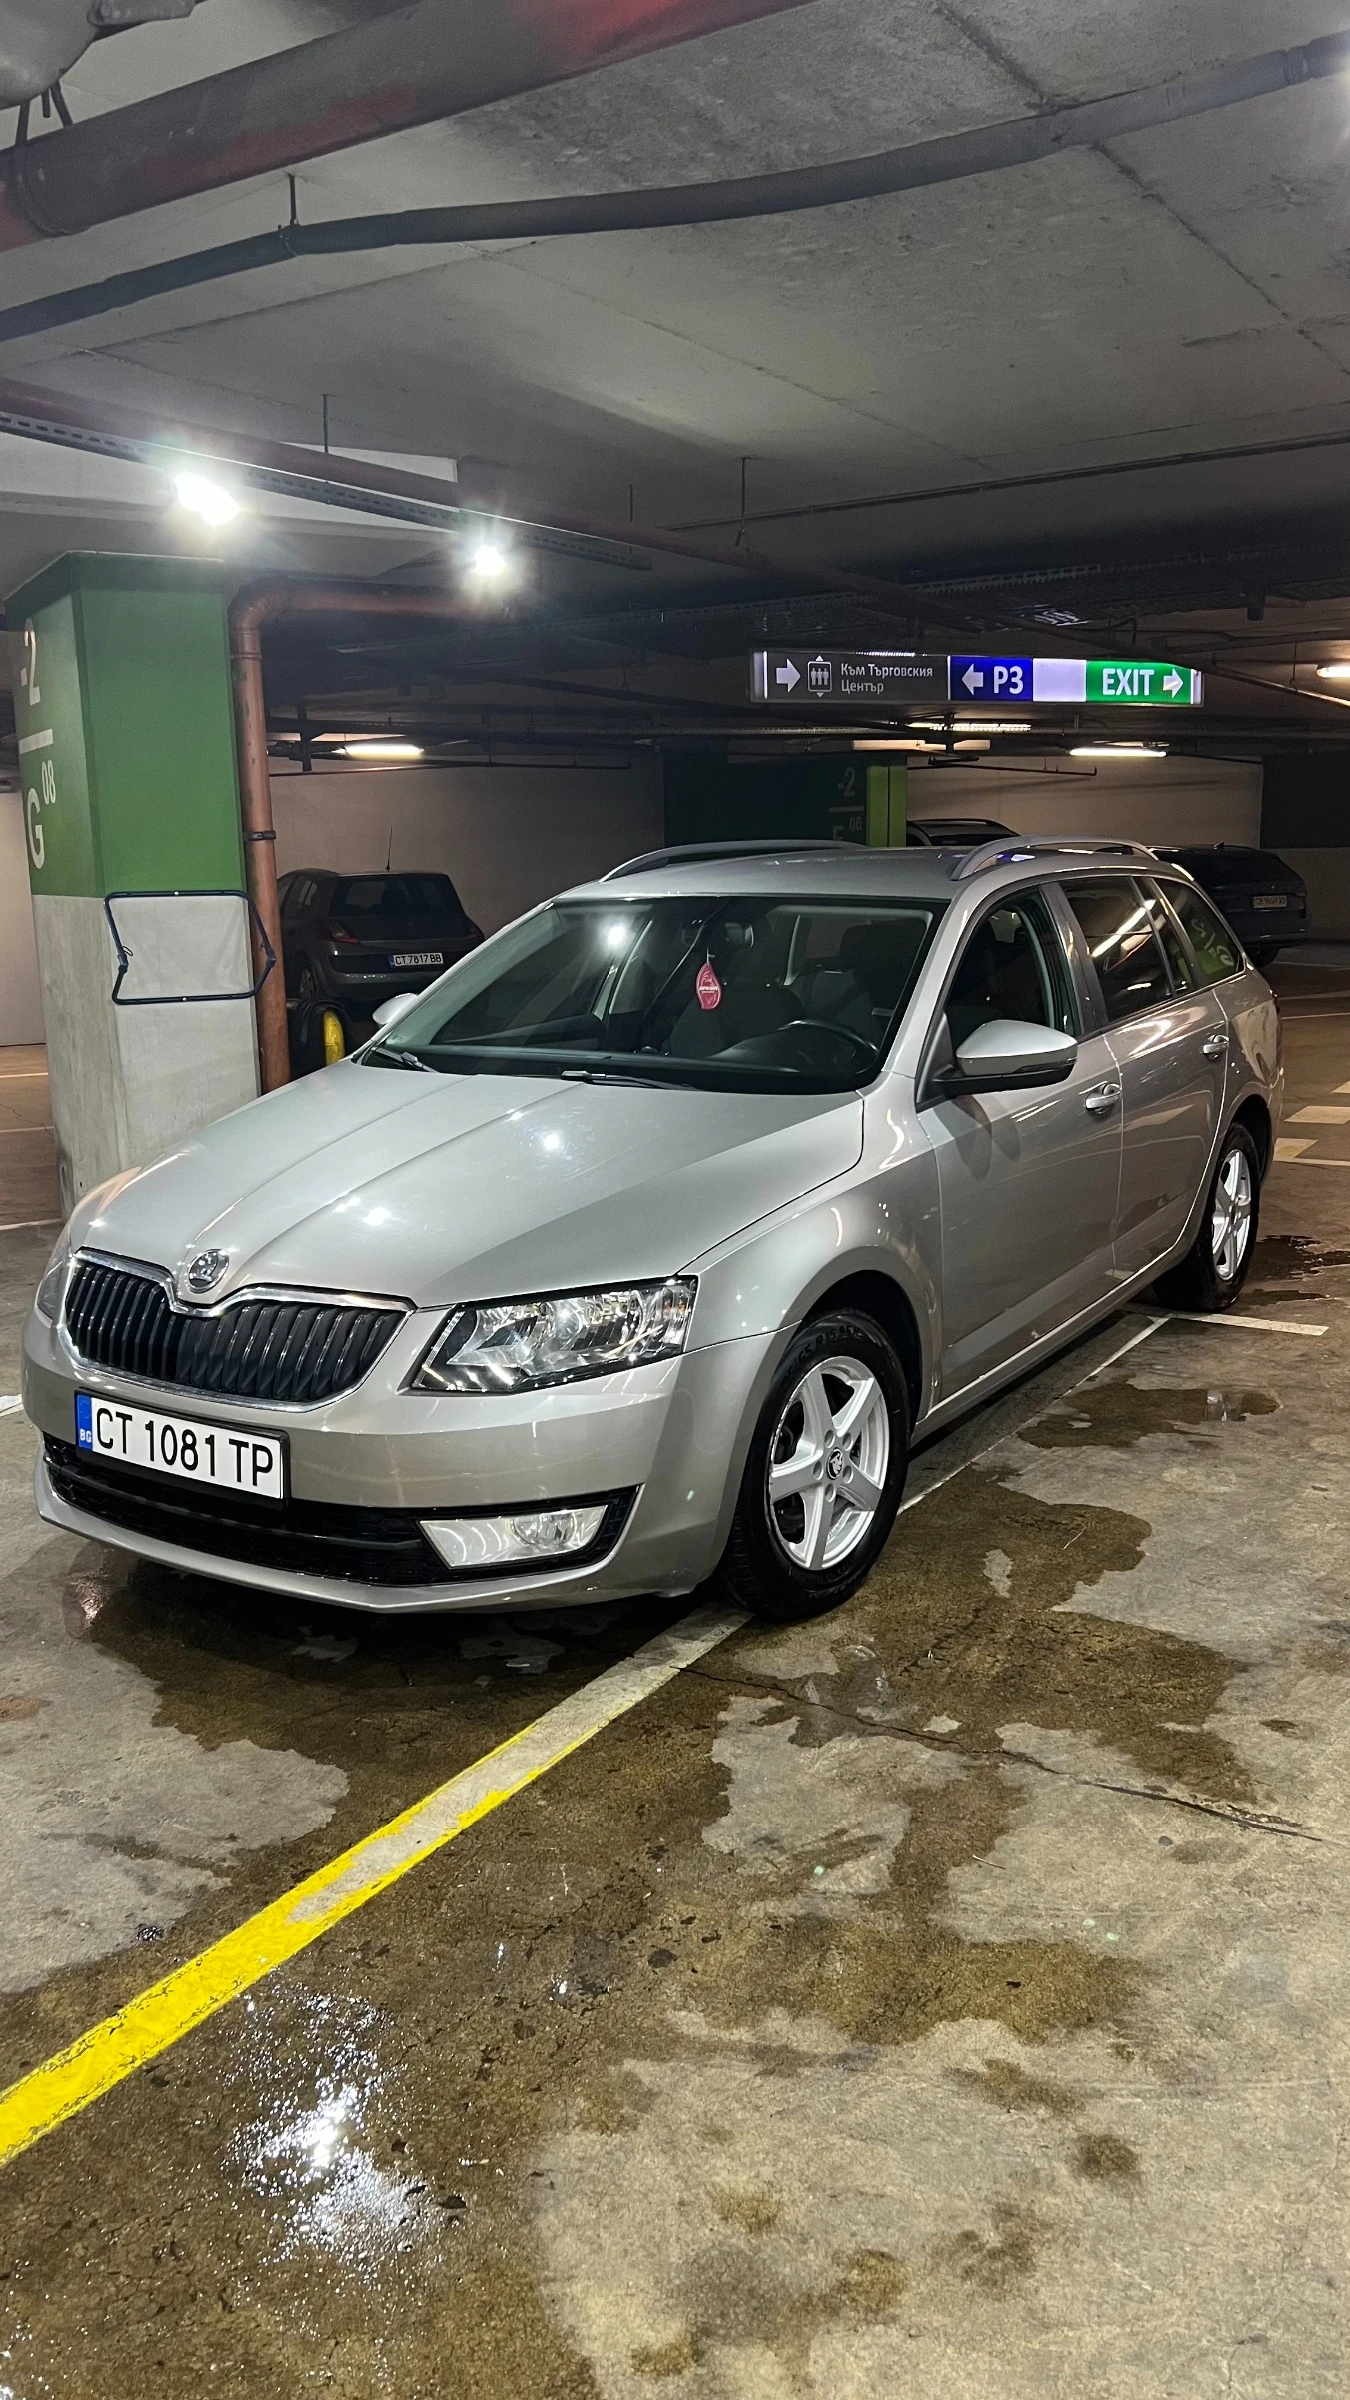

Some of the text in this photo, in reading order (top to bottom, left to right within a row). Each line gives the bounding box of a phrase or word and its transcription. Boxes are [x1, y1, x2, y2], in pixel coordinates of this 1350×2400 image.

[840, 662, 933, 679] Към Търговския
[841, 679, 884, 695] Център
[993, 665, 1025, 695] P3
[1101, 667, 1154, 697] EXIT
[395, 956, 406, 965] CT
[408, 954, 428, 964] 7817
[79, 1428, 92, 1443] BG
[96, 1407, 274, 1487] CT 1081 TP
